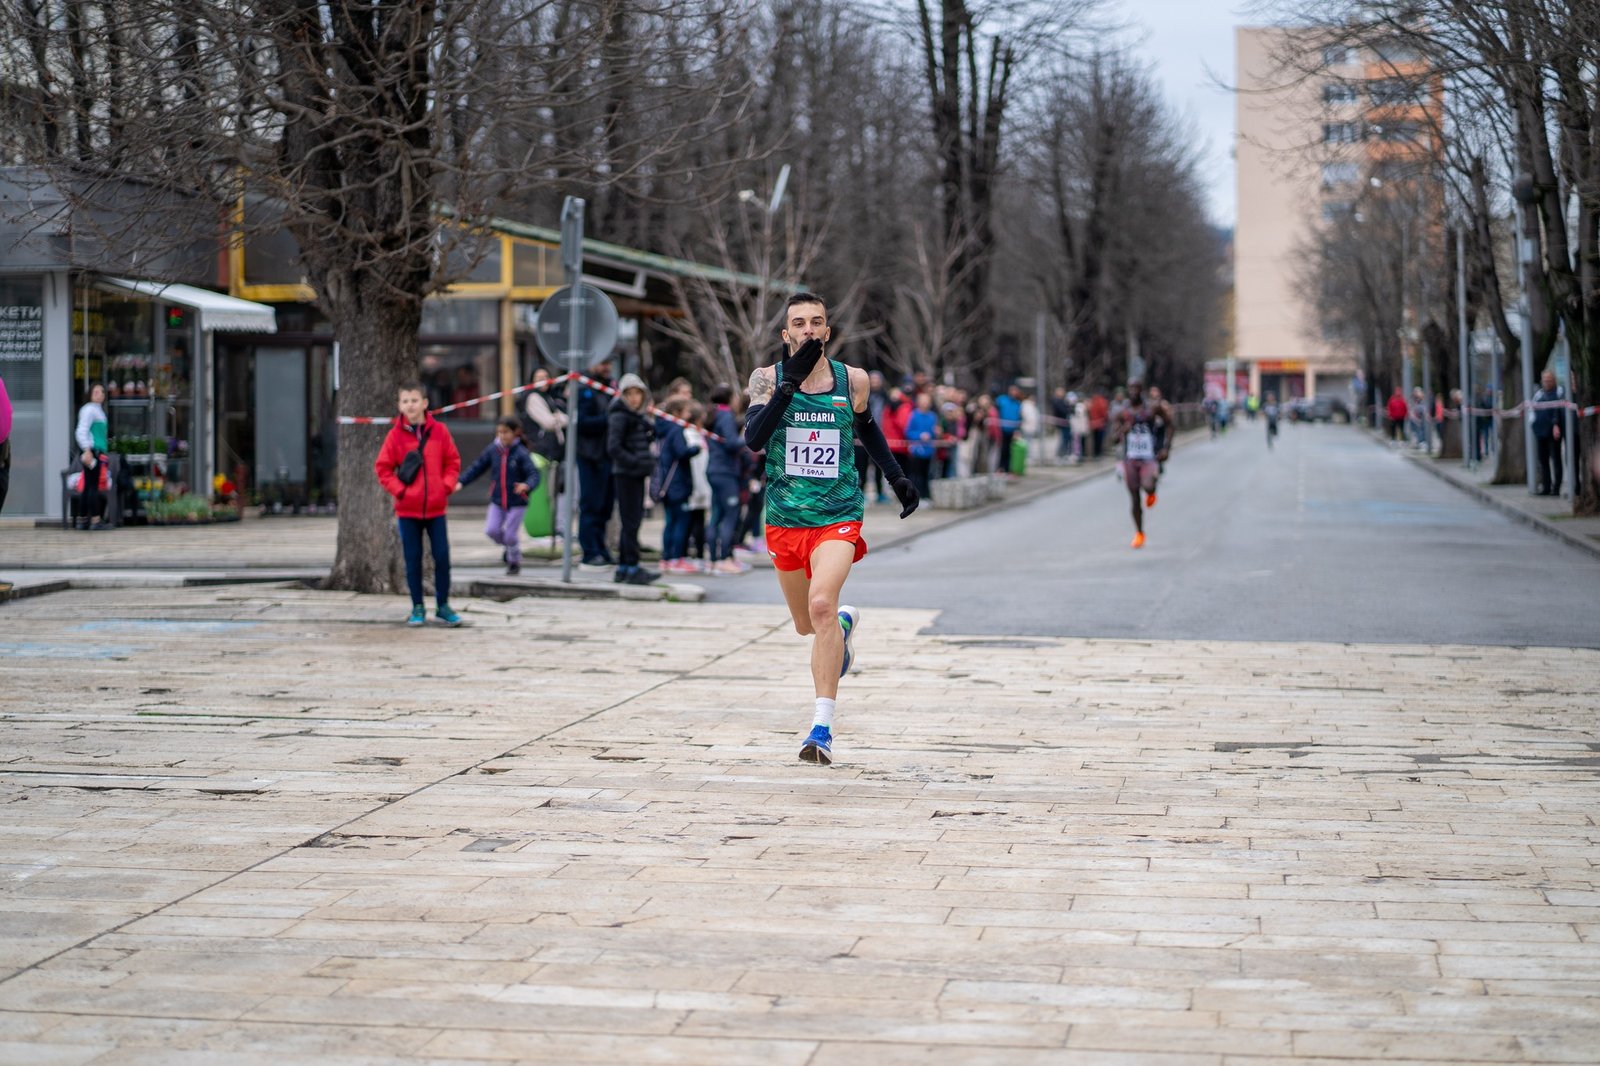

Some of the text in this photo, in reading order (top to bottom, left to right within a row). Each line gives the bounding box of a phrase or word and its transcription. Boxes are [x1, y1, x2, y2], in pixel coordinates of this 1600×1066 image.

[794, 412, 836, 423] BULGARIA
[808, 430, 820, 442] A1
[790, 445, 835, 465] 1122
[806, 468, 825, 476] БФЛА
